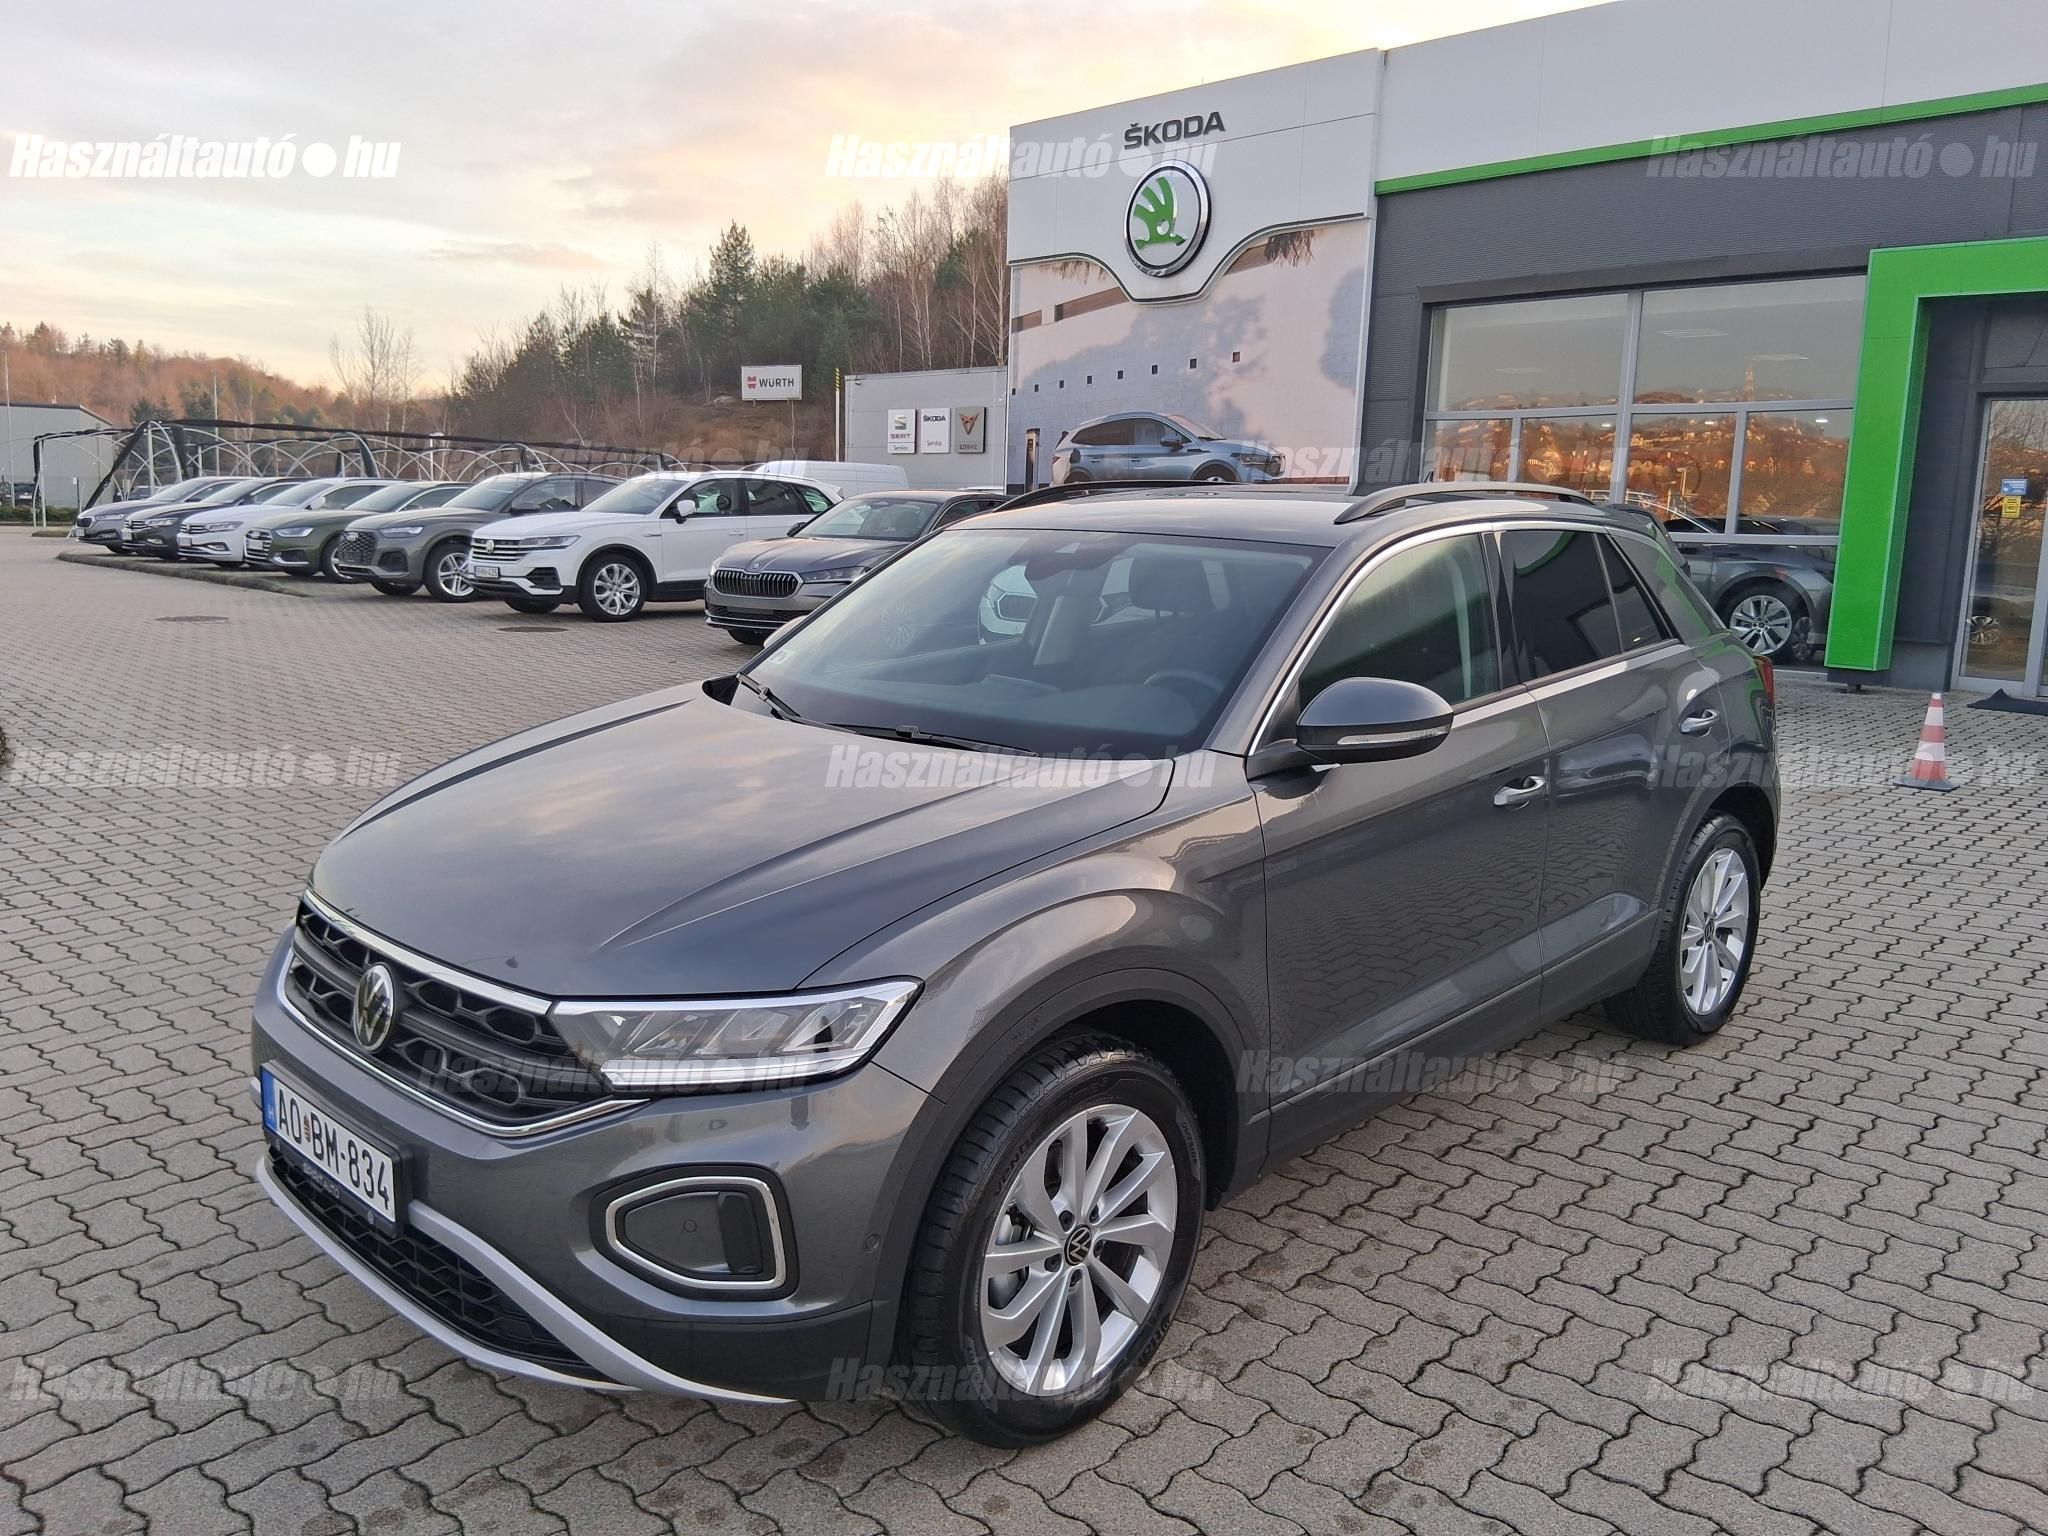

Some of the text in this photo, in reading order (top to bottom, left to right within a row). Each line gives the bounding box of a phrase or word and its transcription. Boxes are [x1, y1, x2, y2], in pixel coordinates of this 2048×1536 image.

[1124, 112, 1226, 150] ŠKODA
[759, 377, 795, 388] WÜRTH
[310, 1111, 390, 1211] BM-834
